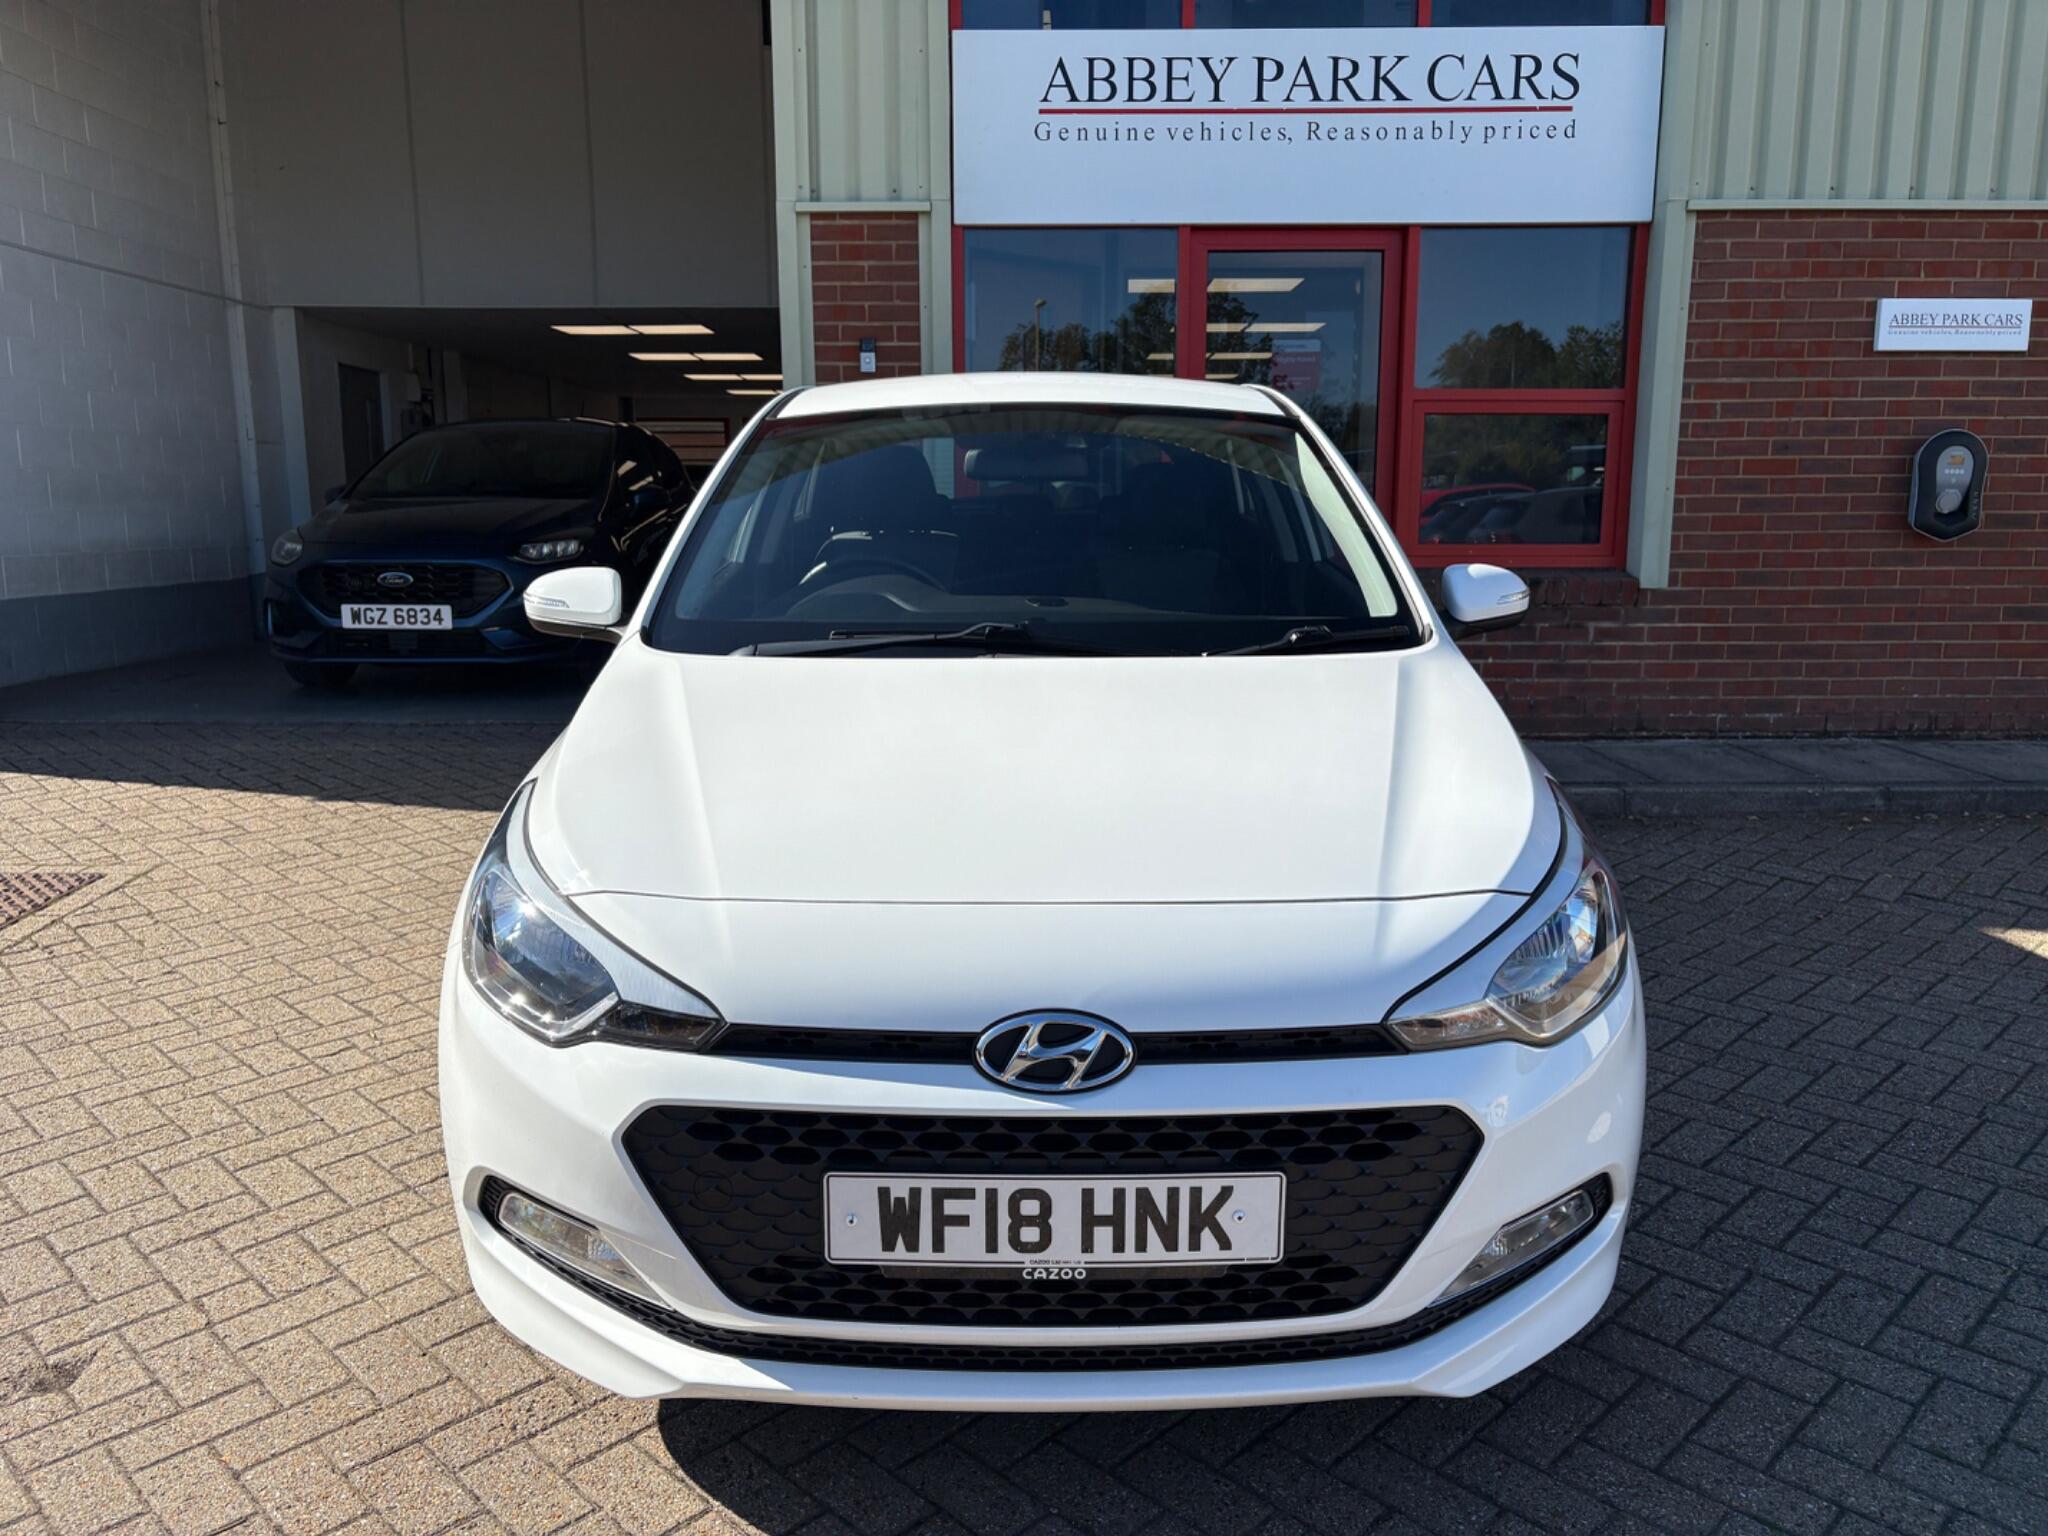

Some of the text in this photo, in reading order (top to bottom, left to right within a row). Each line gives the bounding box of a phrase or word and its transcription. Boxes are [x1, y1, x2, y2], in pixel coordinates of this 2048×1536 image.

[1041, 53, 1581, 103] ABBEY PARK CARS
[1034, 118, 1578, 145] Genuine vehicles, Reasonably priced
[1889, 313, 2023, 326] ABBEY PARK CARS
[350, 607, 444, 625] WGZ 6834
[877, 1185, 1234, 1254] WF18 HNK
[1022, 1268, 1087, 1280] CAZOO
